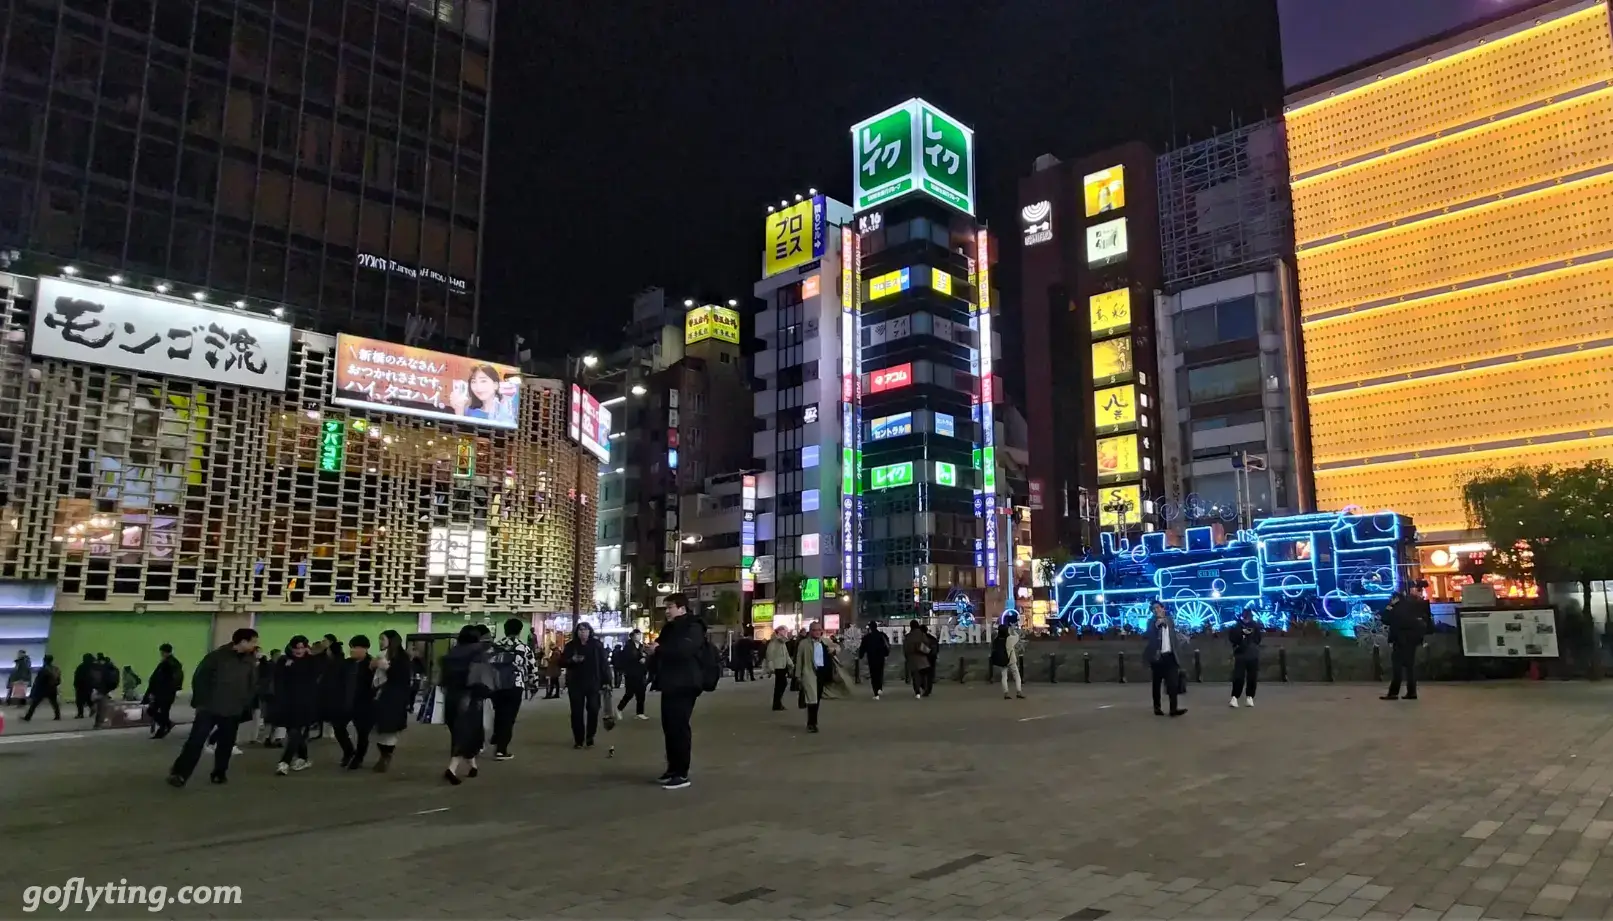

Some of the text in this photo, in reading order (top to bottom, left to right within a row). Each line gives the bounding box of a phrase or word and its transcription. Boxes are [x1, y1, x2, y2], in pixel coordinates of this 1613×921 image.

[776, 214, 802, 240] プロ
[859, 212, 881, 230] K 16
[776, 236, 802, 260] ミス
[44, 297, 268, 374] モンゴ流
[884, 371, 907, 384] アコム
[874, 424, 905, 439] セントラル
[876, 466, 906, 483] レイク
